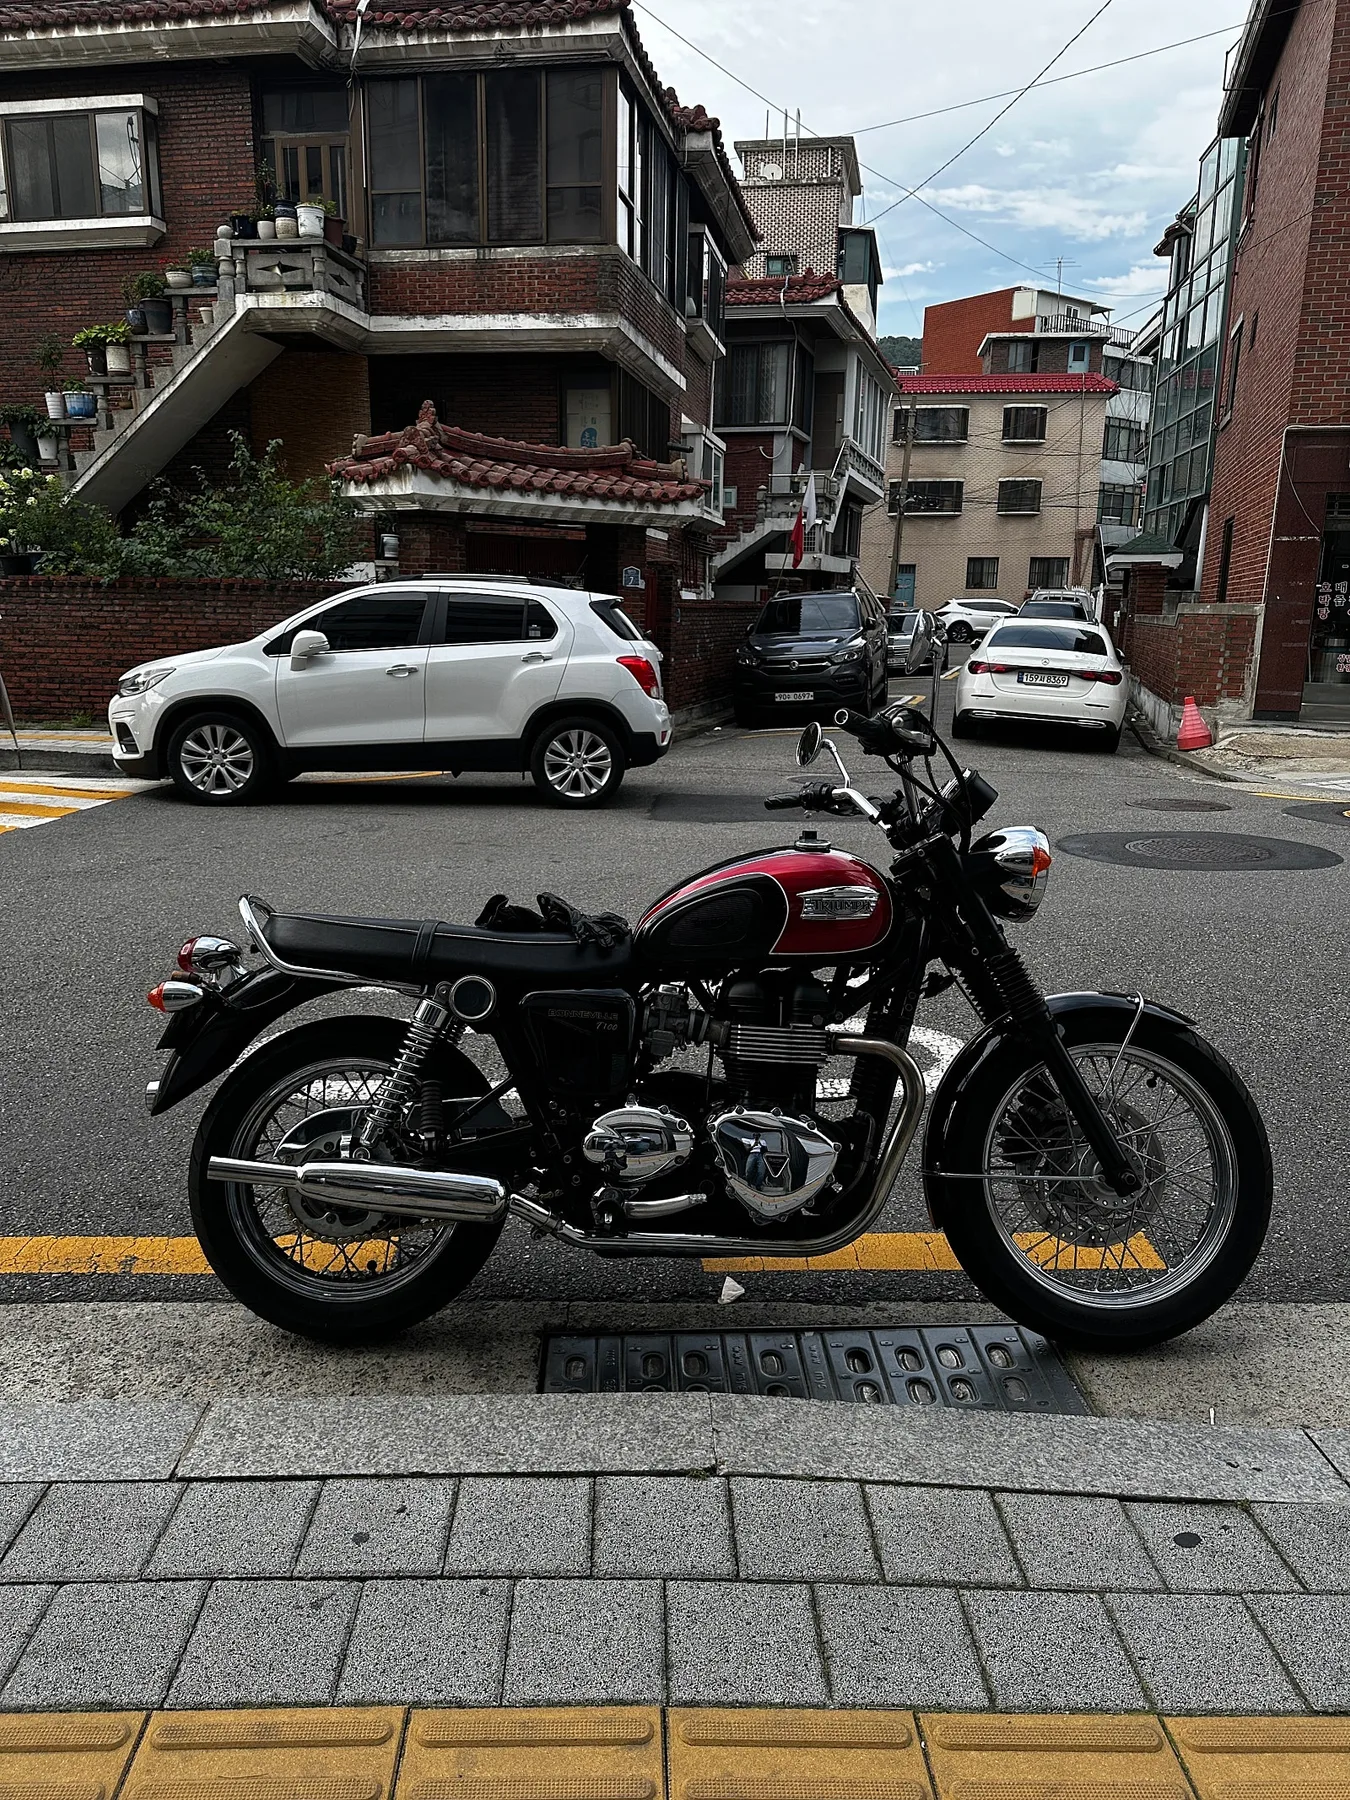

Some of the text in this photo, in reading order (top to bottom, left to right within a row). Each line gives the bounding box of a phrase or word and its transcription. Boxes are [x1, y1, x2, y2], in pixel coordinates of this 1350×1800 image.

[794, 692, 811, 700] 0697
[811, 899, 872, 914] TRIUMPH
[547, 1008, 619, 1020] BONNEVILLE
[596, 1021, 619, 1031] T100
